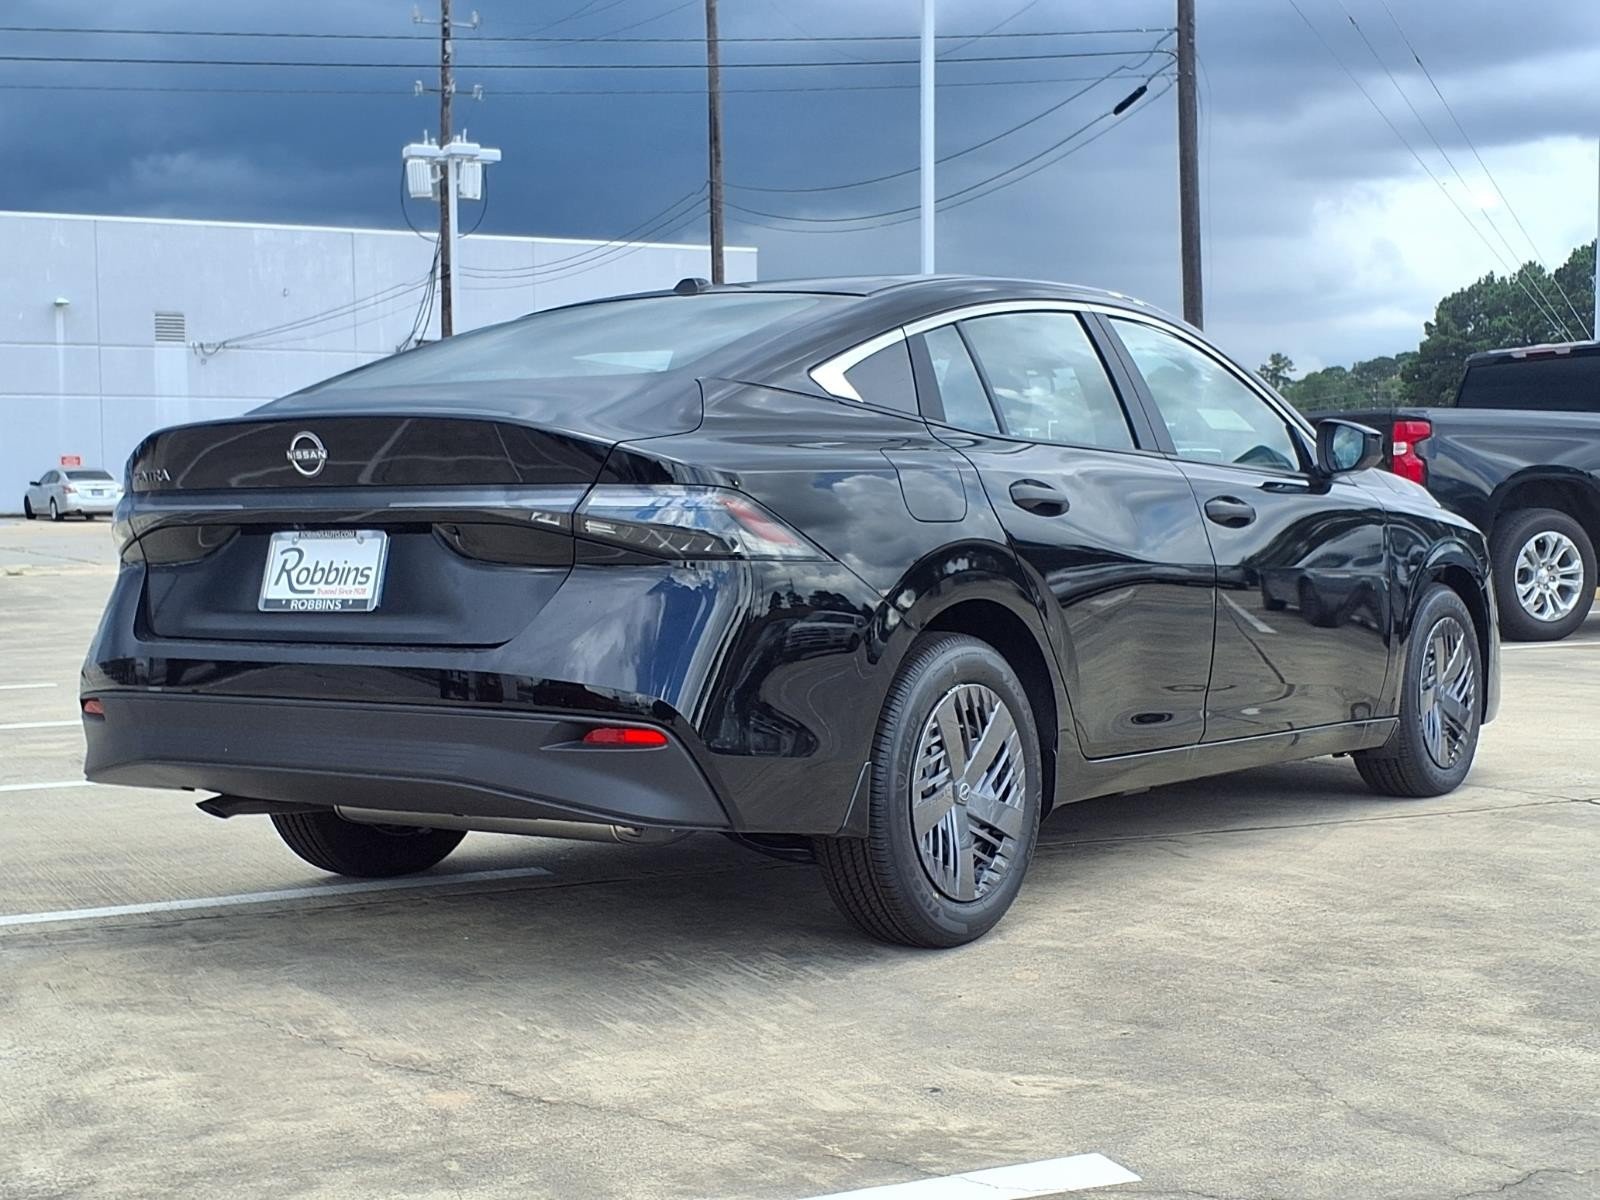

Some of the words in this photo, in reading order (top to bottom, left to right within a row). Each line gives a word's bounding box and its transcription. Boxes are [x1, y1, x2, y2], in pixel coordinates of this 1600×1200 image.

[287, 449, 328, 461] NISSAN
[274, 547, 373, 595] Robbins
[290, 599, 342, 610] ROBBINS
